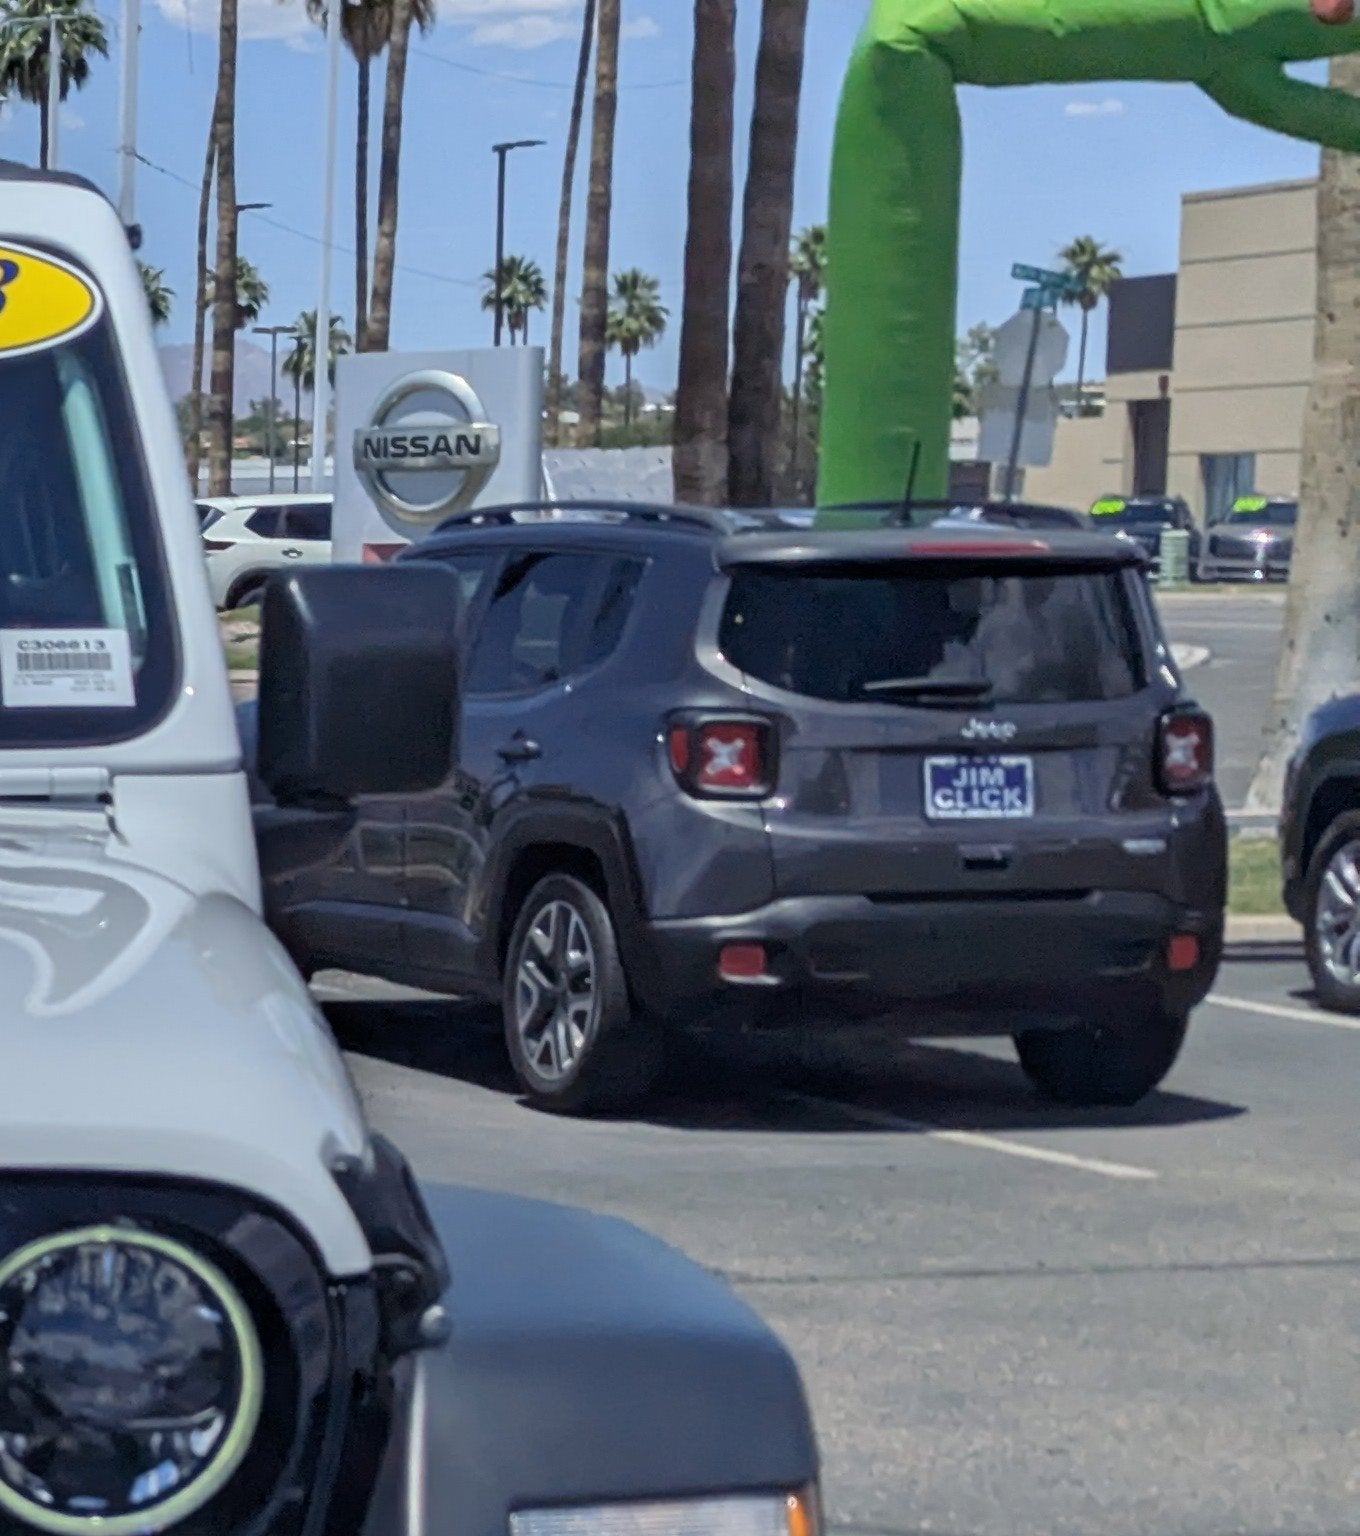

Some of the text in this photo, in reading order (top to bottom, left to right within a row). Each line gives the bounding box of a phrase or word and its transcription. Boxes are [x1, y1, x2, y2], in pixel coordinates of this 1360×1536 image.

[363, 434, 481, 459] NISSAN
[952, 766, 1005, 788] JIM
[934, 787, 1023, 809] CLICK
